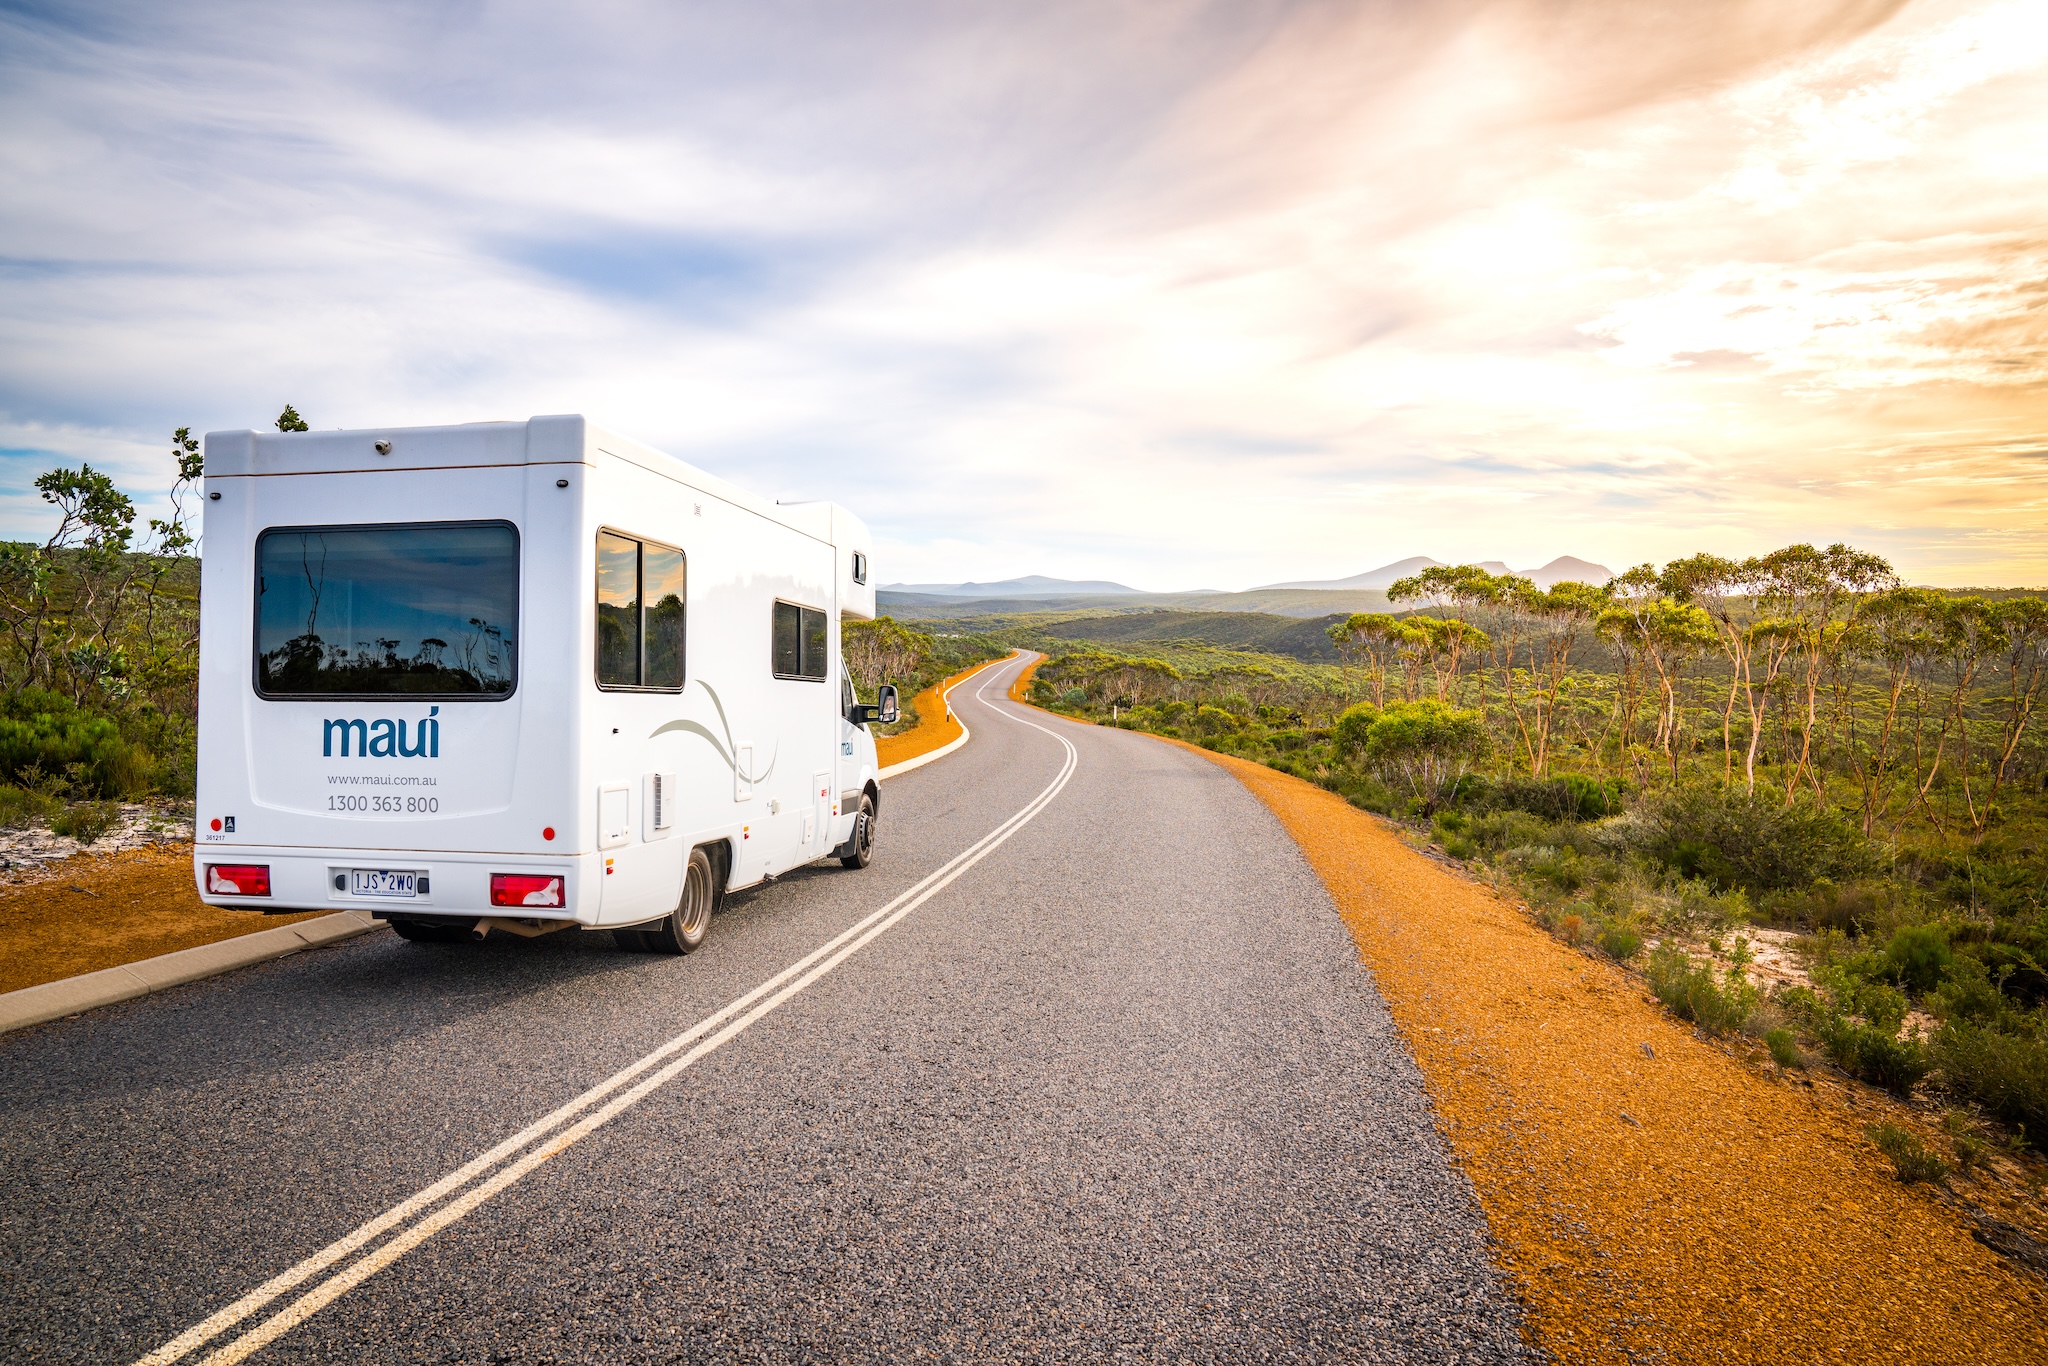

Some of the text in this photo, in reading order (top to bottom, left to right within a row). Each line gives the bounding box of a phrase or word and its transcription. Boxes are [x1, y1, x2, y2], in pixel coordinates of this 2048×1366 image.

[327, 774, 438, 786] www.maui.com.au
[328, 795, 439, 813] 1300 363 800
[356, 873, 412, 890] 1JS 2WQ
